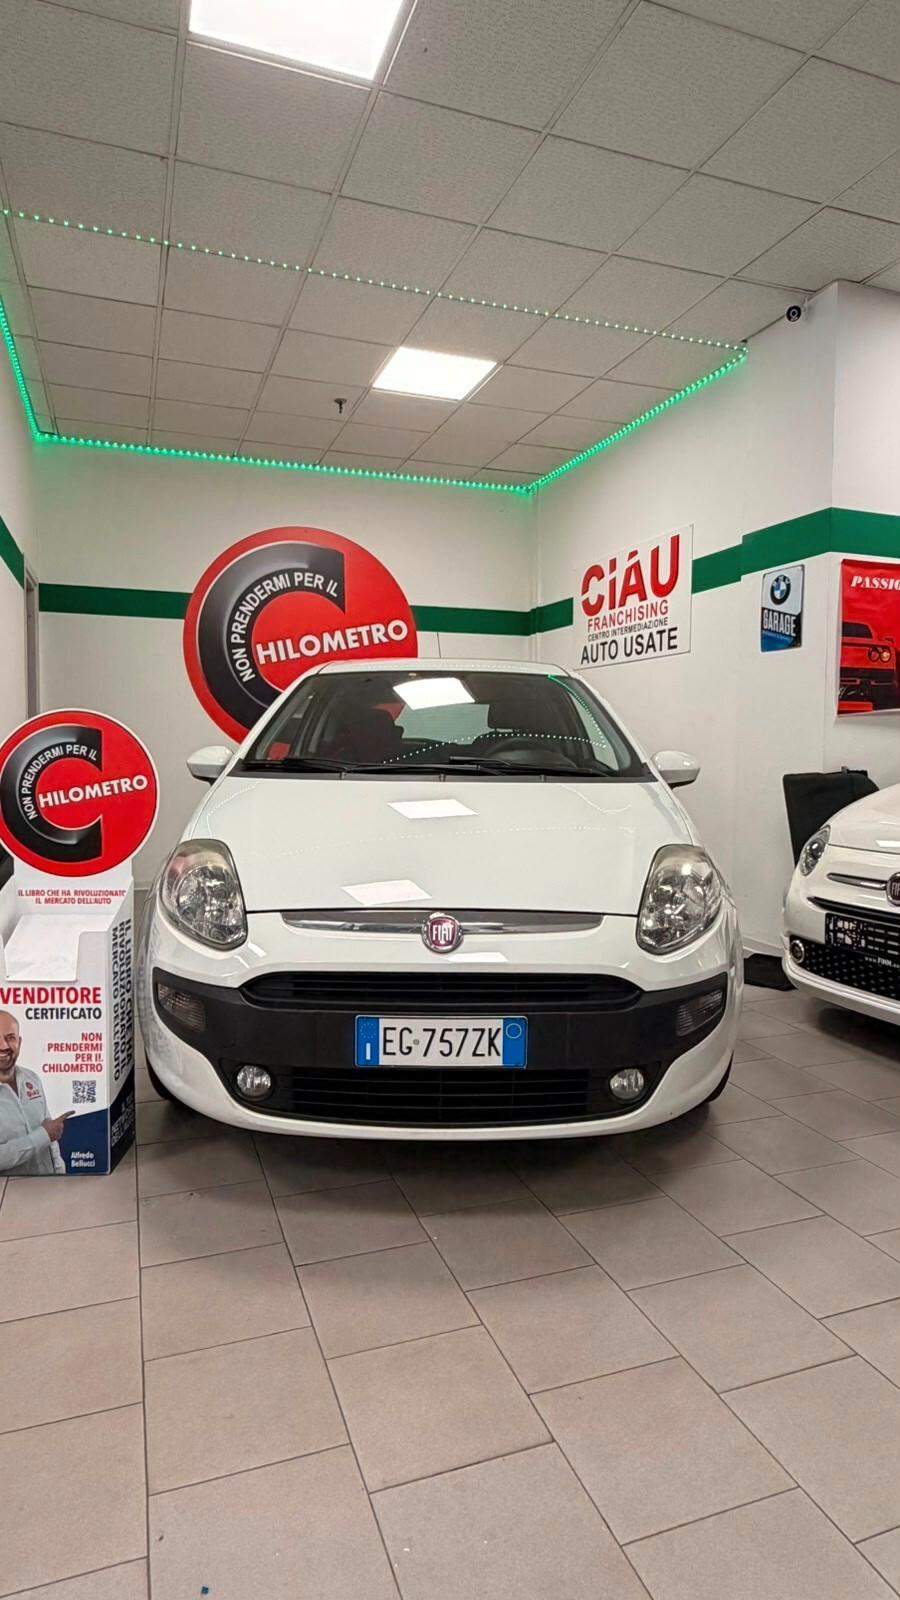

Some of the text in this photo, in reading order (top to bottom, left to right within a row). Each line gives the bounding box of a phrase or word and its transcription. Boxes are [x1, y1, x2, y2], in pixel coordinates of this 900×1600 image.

[588, 599, 668, 633] FRANCHISING
[763, 609, 796, 637] GARAGE
[230, 572, 338, 682] NON PRENDERMI PER IL
[588, 617, 668, 642] CENTRO INTERMEDIAZIONE
[581, 626, 678, 665] AUTO USATE
[21, 744, 97, 820] NON PRENDERMI PER IL
[17, 889, 24, 897] IL
[25, 889, 45, 897] LIBRO
[47, 889, 60, 897] CHE
[61, 889, 71, 897] HA
[35, 897, 111, 905] IL MERCATO DELL'AUTO
[432, 922, 454, 944] FIAT
[0, 986, 102, 1005] VENDITORE
[25, 1007, 103, 1020] CERTIFICATO
[81, 1032, 103, 1042] NON
[47, 1042, 103, 1052] PRENDERMI
[75, 1053, 93, 1062] PER
[42, 1063, 103, 1073] CHILOMETRO
[71, 1151, 95, 1160] Alfredo
